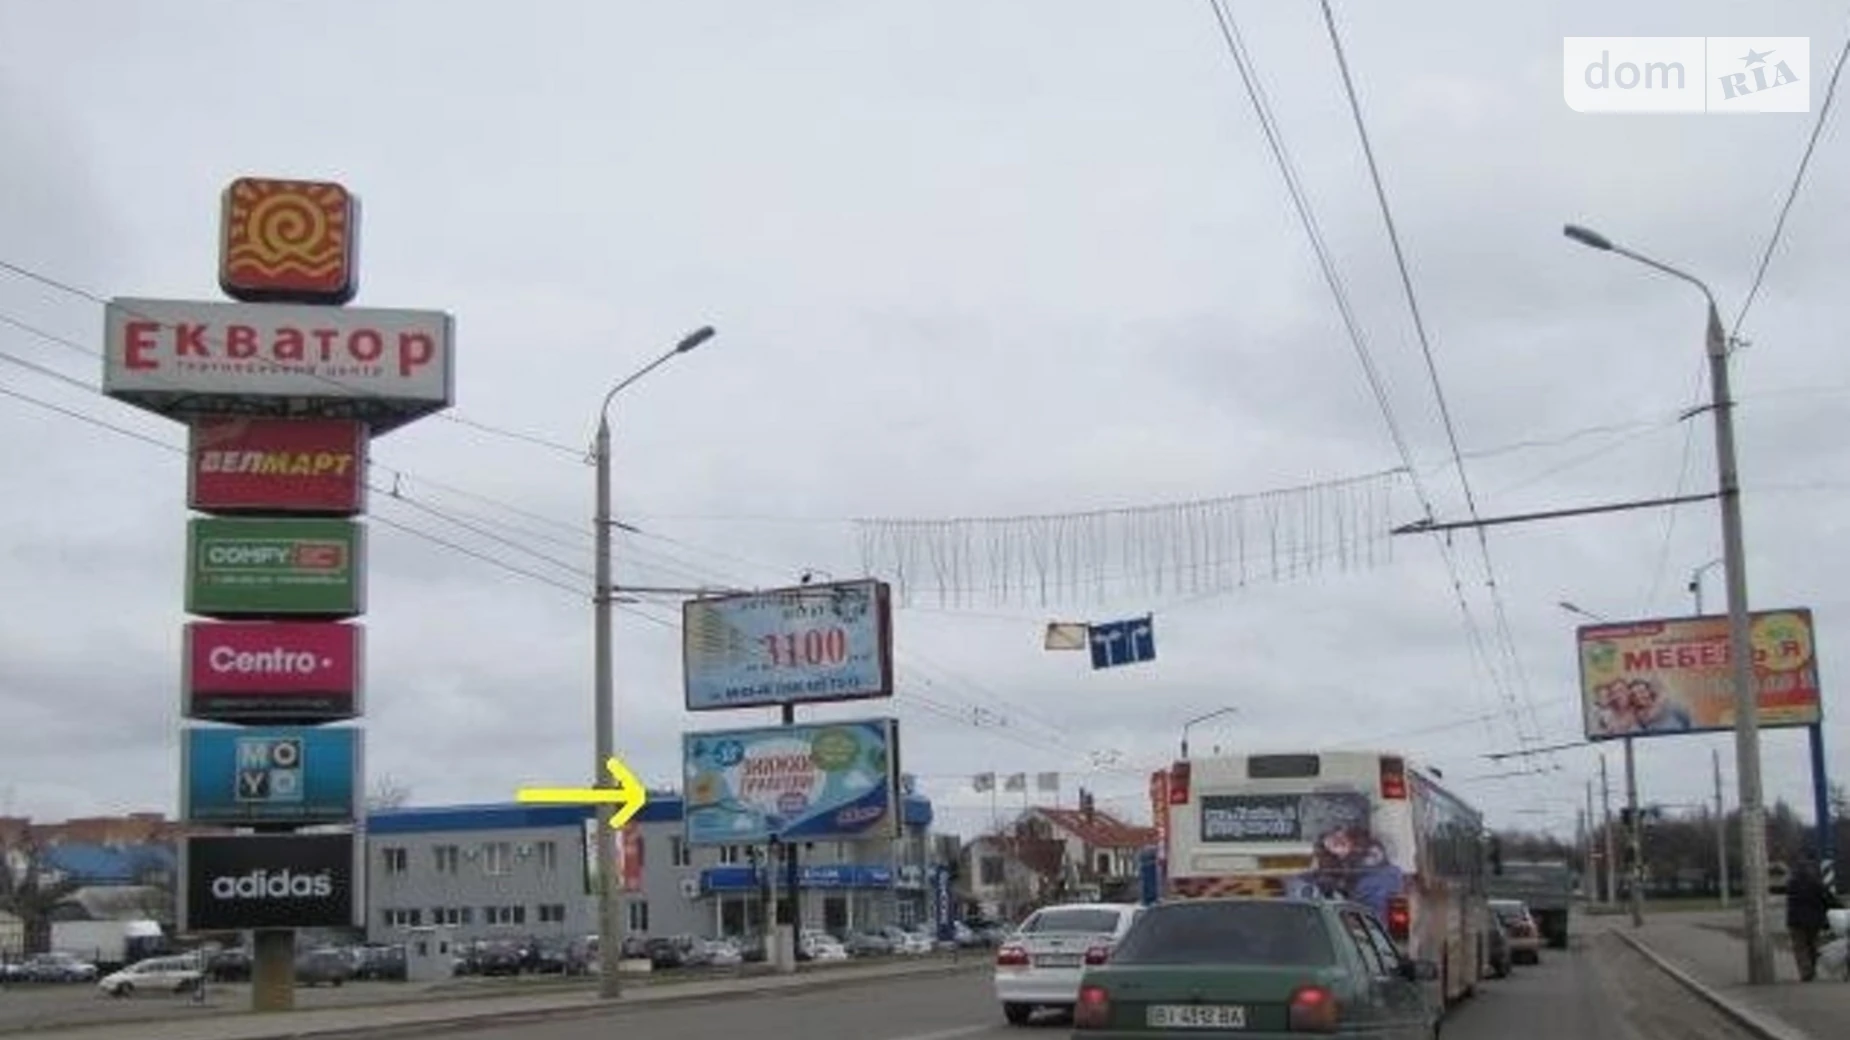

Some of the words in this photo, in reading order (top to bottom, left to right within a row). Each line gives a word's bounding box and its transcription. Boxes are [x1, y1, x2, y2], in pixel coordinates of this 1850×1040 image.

[200, 451, 352, 475] ВЕЛМАРТ
[209, 546, 290, 564] COMFY
[209, 646, 316, 673] Centro
[212, 869, 333, 898] adidas
